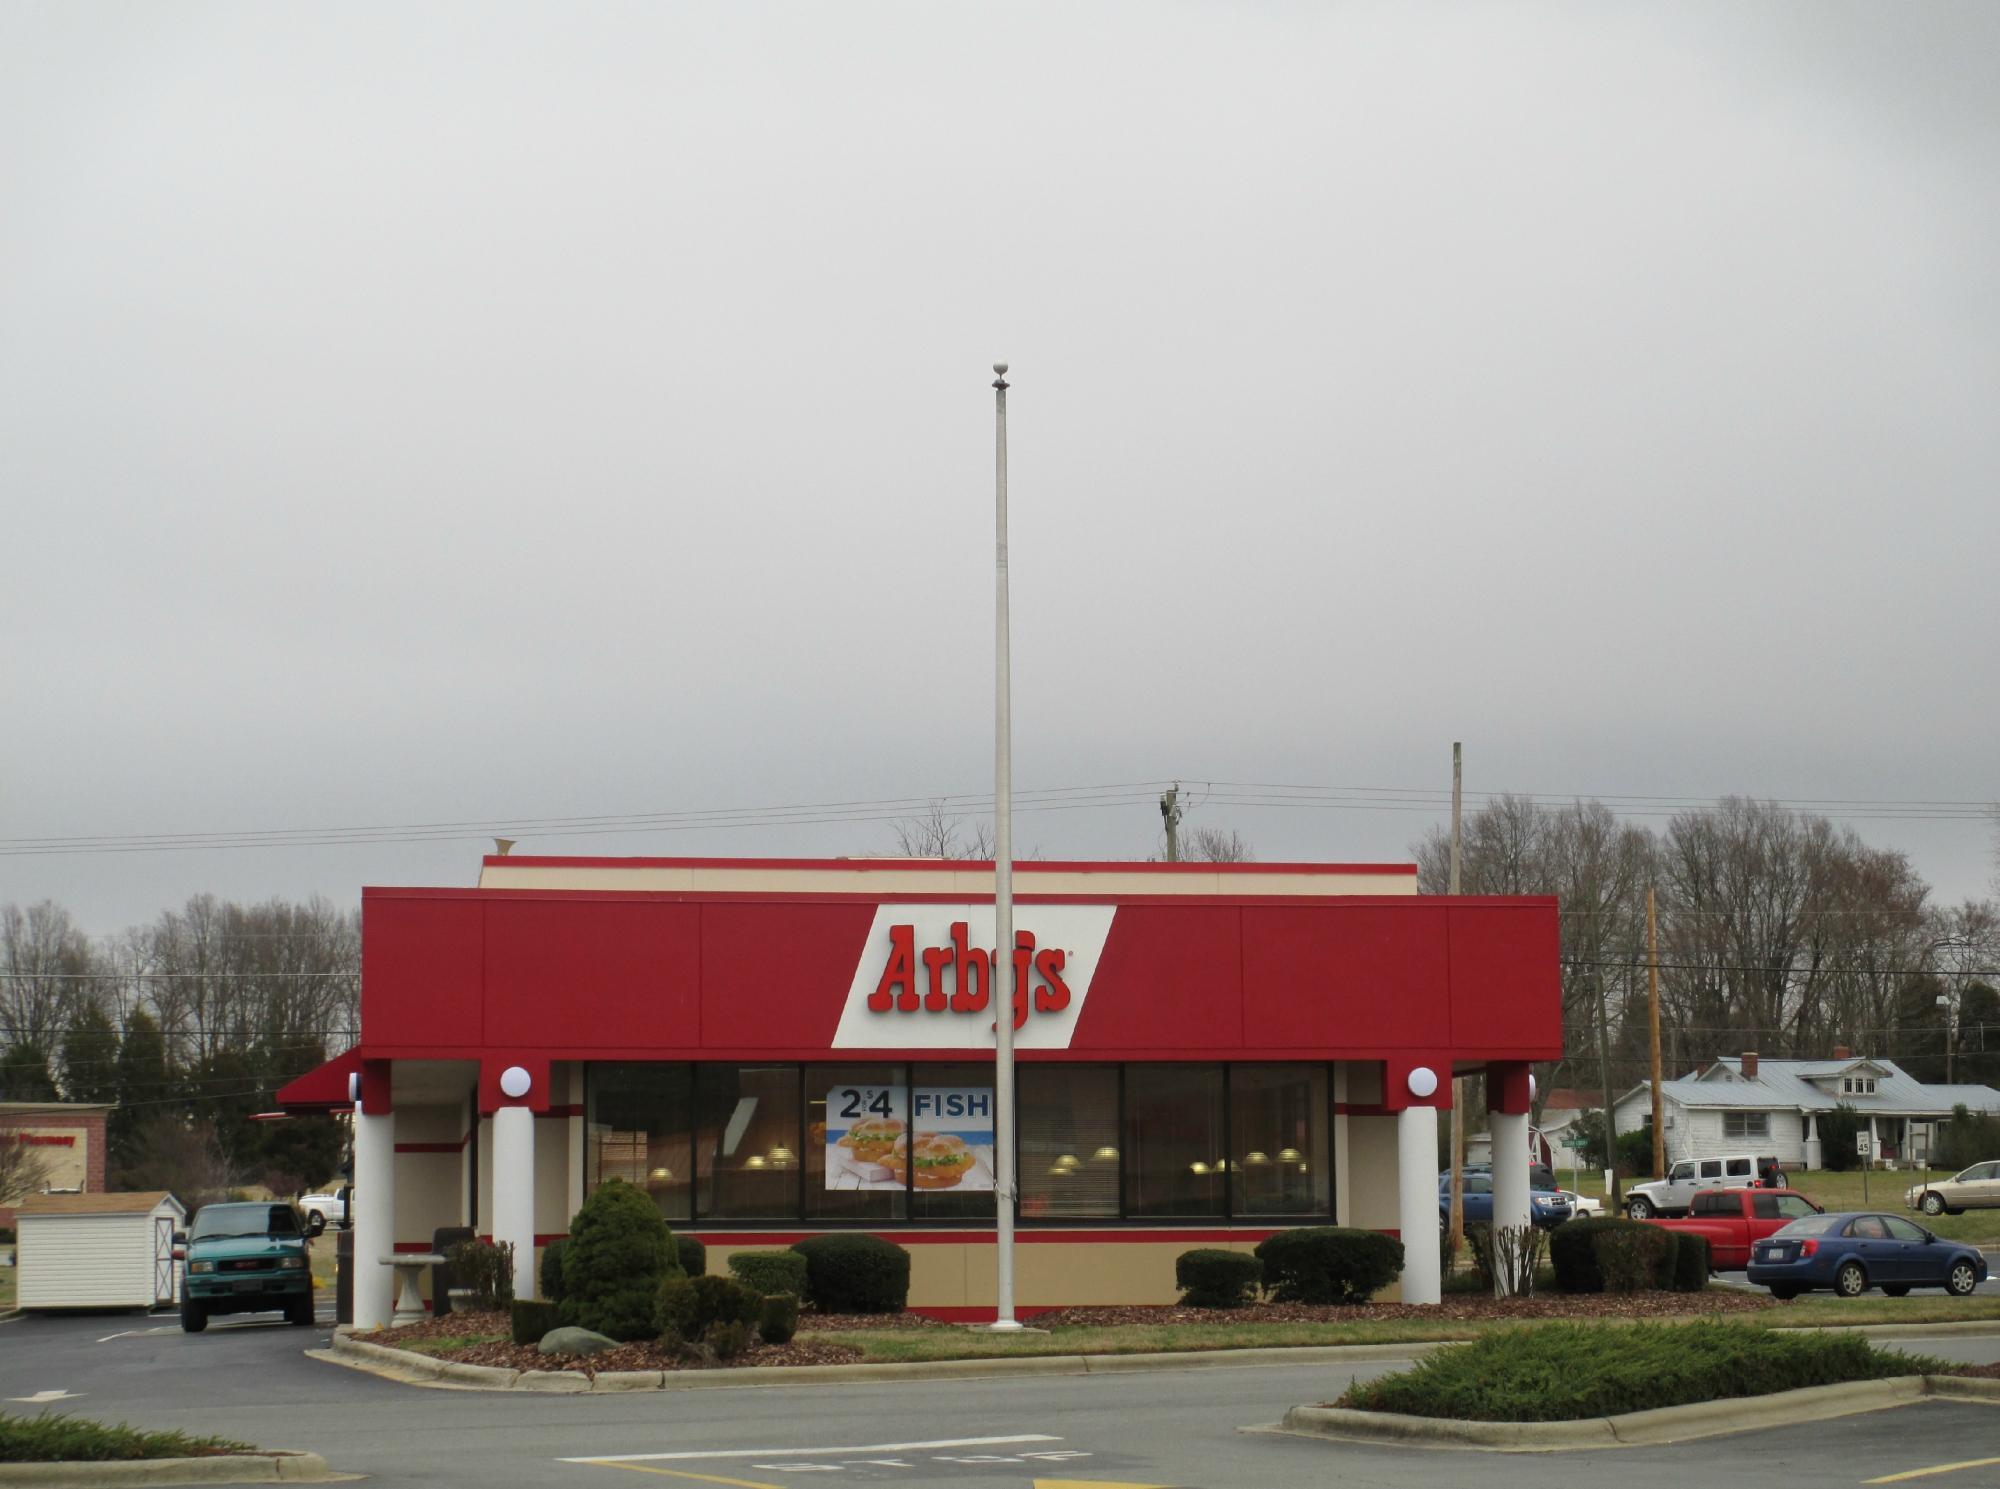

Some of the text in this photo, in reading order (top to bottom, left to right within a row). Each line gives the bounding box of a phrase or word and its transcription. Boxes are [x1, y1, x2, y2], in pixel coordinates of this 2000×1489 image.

[867, 921, 1071, 1033] Arby's
[840, 1089, 861, 1118] 2
[914, 1094, 991, 1118] FISH
[1858, 1143, 1869, 1152] 45
